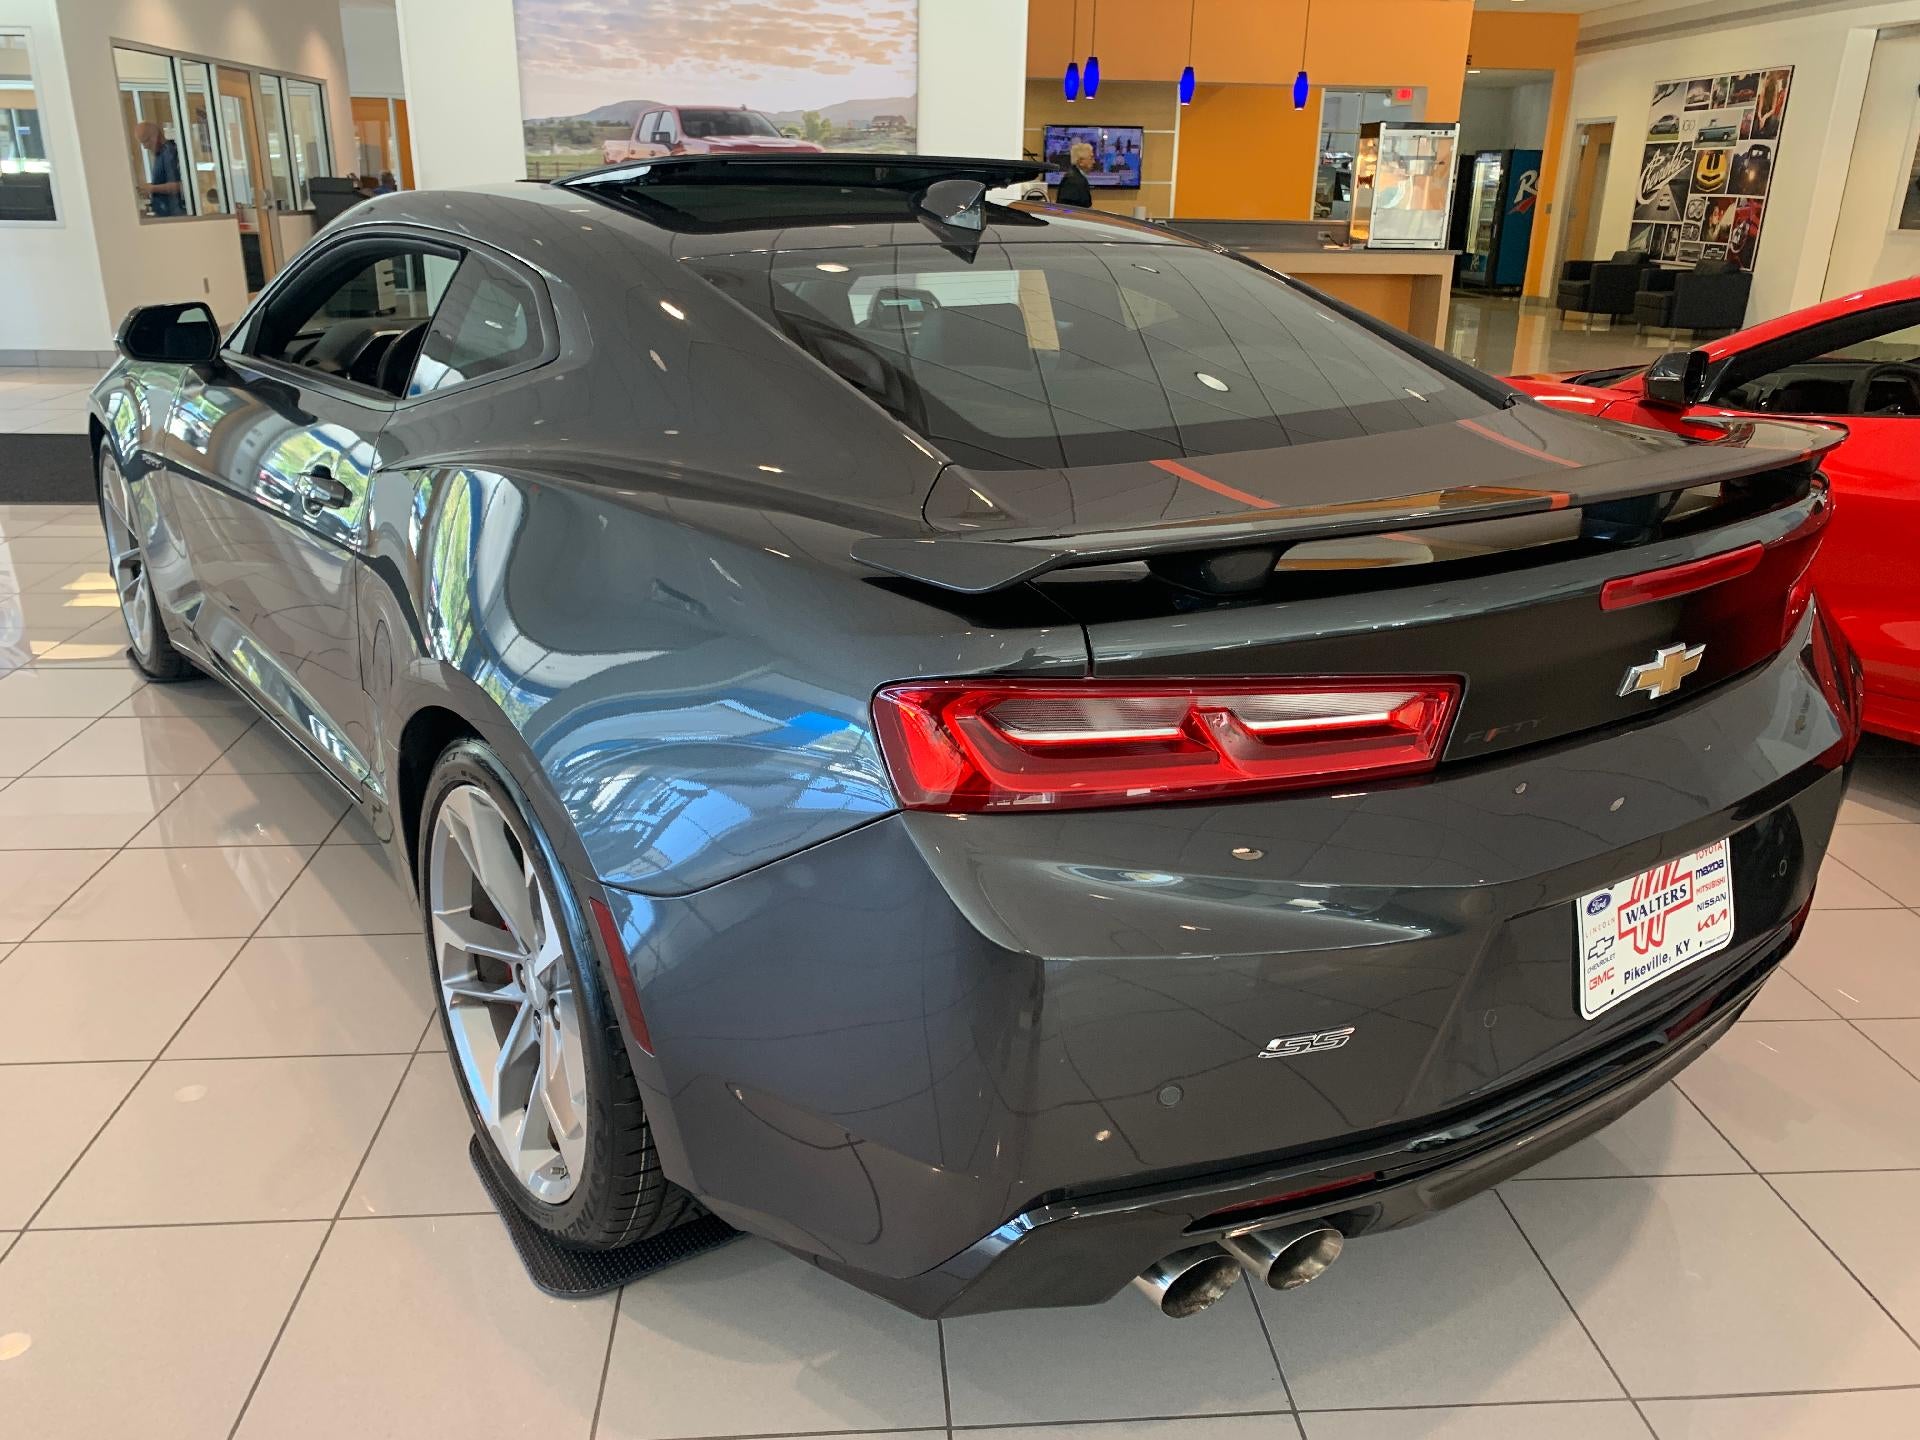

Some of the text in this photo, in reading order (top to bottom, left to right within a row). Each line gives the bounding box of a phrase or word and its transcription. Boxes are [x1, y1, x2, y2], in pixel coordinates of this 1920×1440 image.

[1514, 169, 1538, 204] R
[1696, 842, 1723, 860] TOYOTA
[1696, 876, 1726, 895] MITSUBISHI
[1625, 884, 1687, 925] WALTERS
[1696, 892, 1727, 912] NISSAN
[1585, 917, 1616, 939] LINCOLN
[1697, 908, 1728, 932] KIA
[1586, 953, 1616, 974] CHEVROLET
[1623, 938, 1691, 985] Pikeville, KY
[1588, 966, 1616, 991] GMC
[1258, 1027, 1356, 1059] SS
